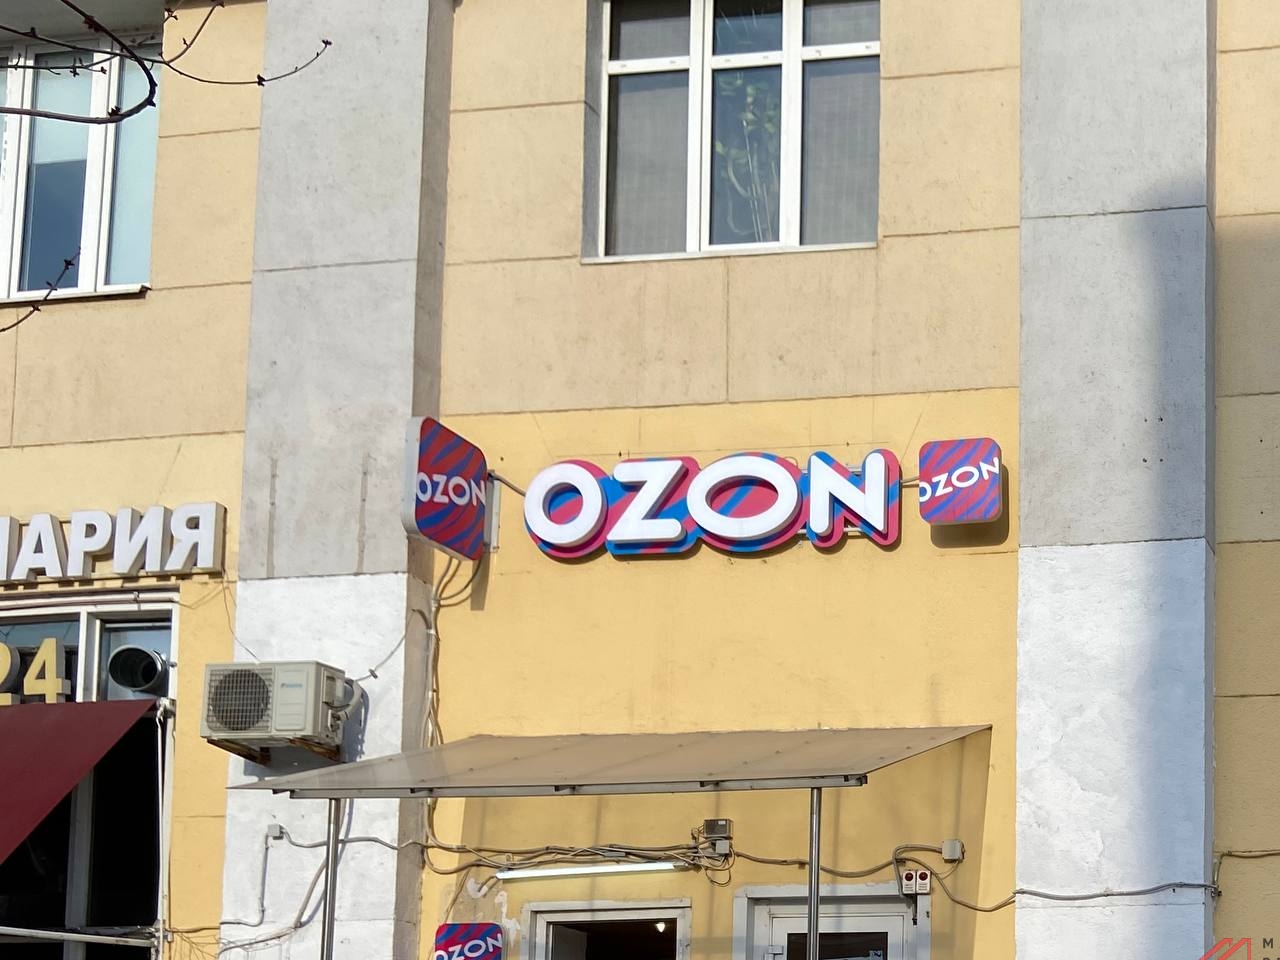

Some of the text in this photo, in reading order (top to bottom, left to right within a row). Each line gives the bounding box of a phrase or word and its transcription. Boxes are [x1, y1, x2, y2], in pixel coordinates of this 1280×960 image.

[416, 472, 486, 506] OZON
[523, 450, 888, 545] OZON
[919, 457, 999, 502] OZON
[0, 502, 217, 580] АРИЯ
